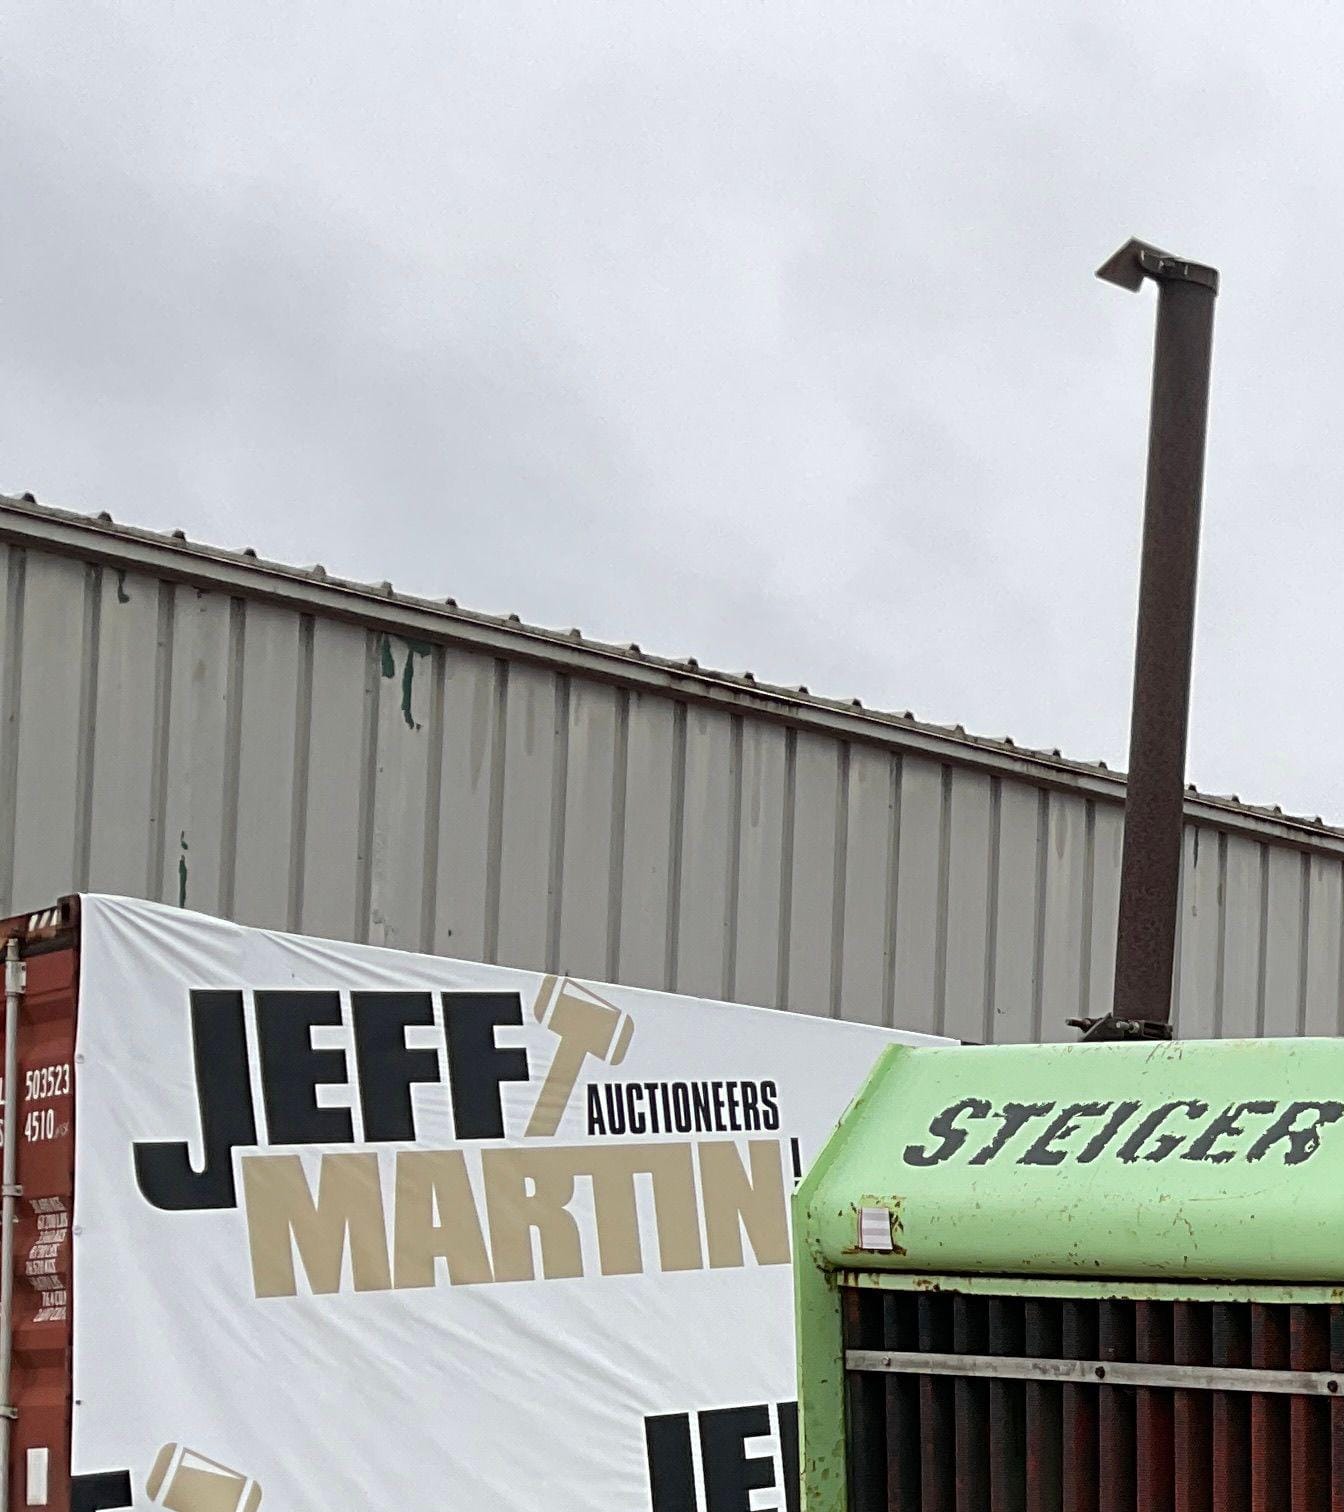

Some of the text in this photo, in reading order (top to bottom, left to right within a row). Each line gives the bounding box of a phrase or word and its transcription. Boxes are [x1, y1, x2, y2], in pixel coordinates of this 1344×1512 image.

[25, 1064, 70, 1101] 503523
[133, 989, 529, 1210] JEFF
[586, 1080, 780, 1136] AUCTIONEERS
[24, 1108, 55, 1142] 4510
[242, 1139, 791, 1298] MARTIN
